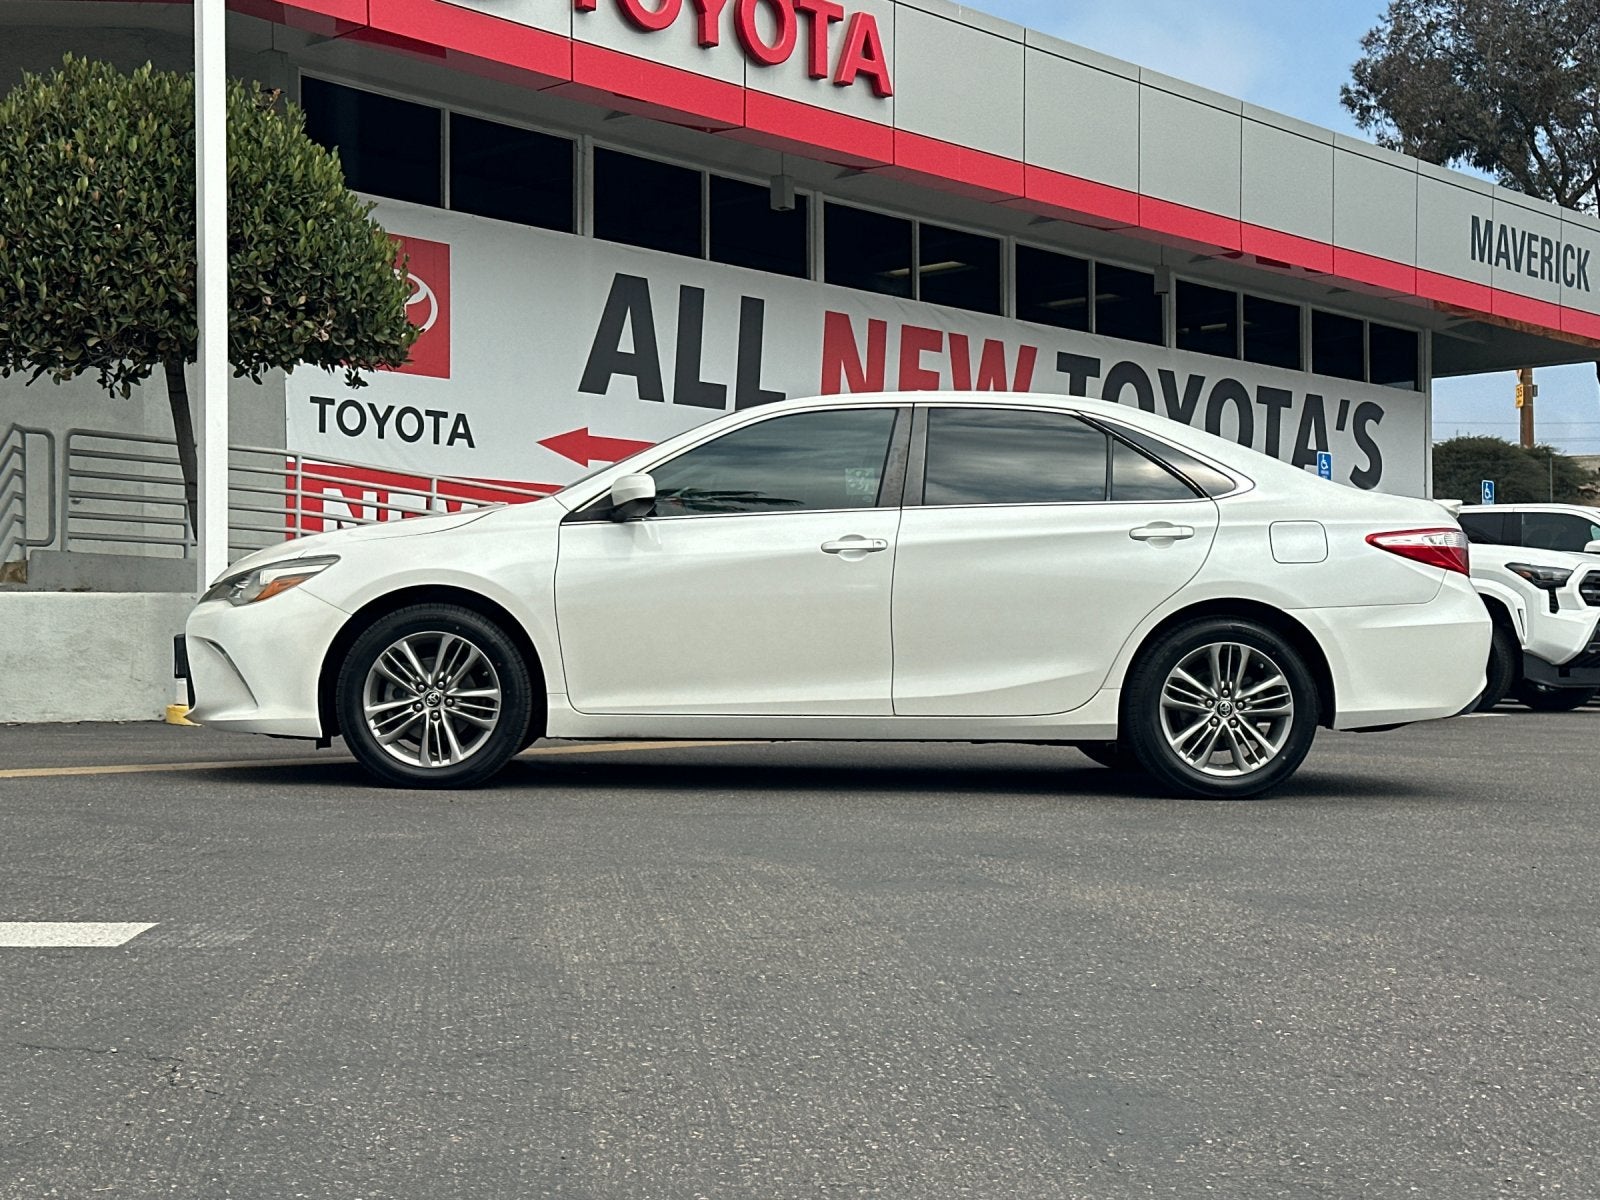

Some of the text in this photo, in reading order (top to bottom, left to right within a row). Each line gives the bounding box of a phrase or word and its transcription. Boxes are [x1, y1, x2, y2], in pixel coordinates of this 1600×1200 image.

[574, 0, 893, 98] YOTA
[1471, 214, 1590, 292] MAVERICK
[578, 272, 786, 411] ALL
[820, 310, 1038, 395] NEW
[309, 395, 476, 449] TOYOTA
